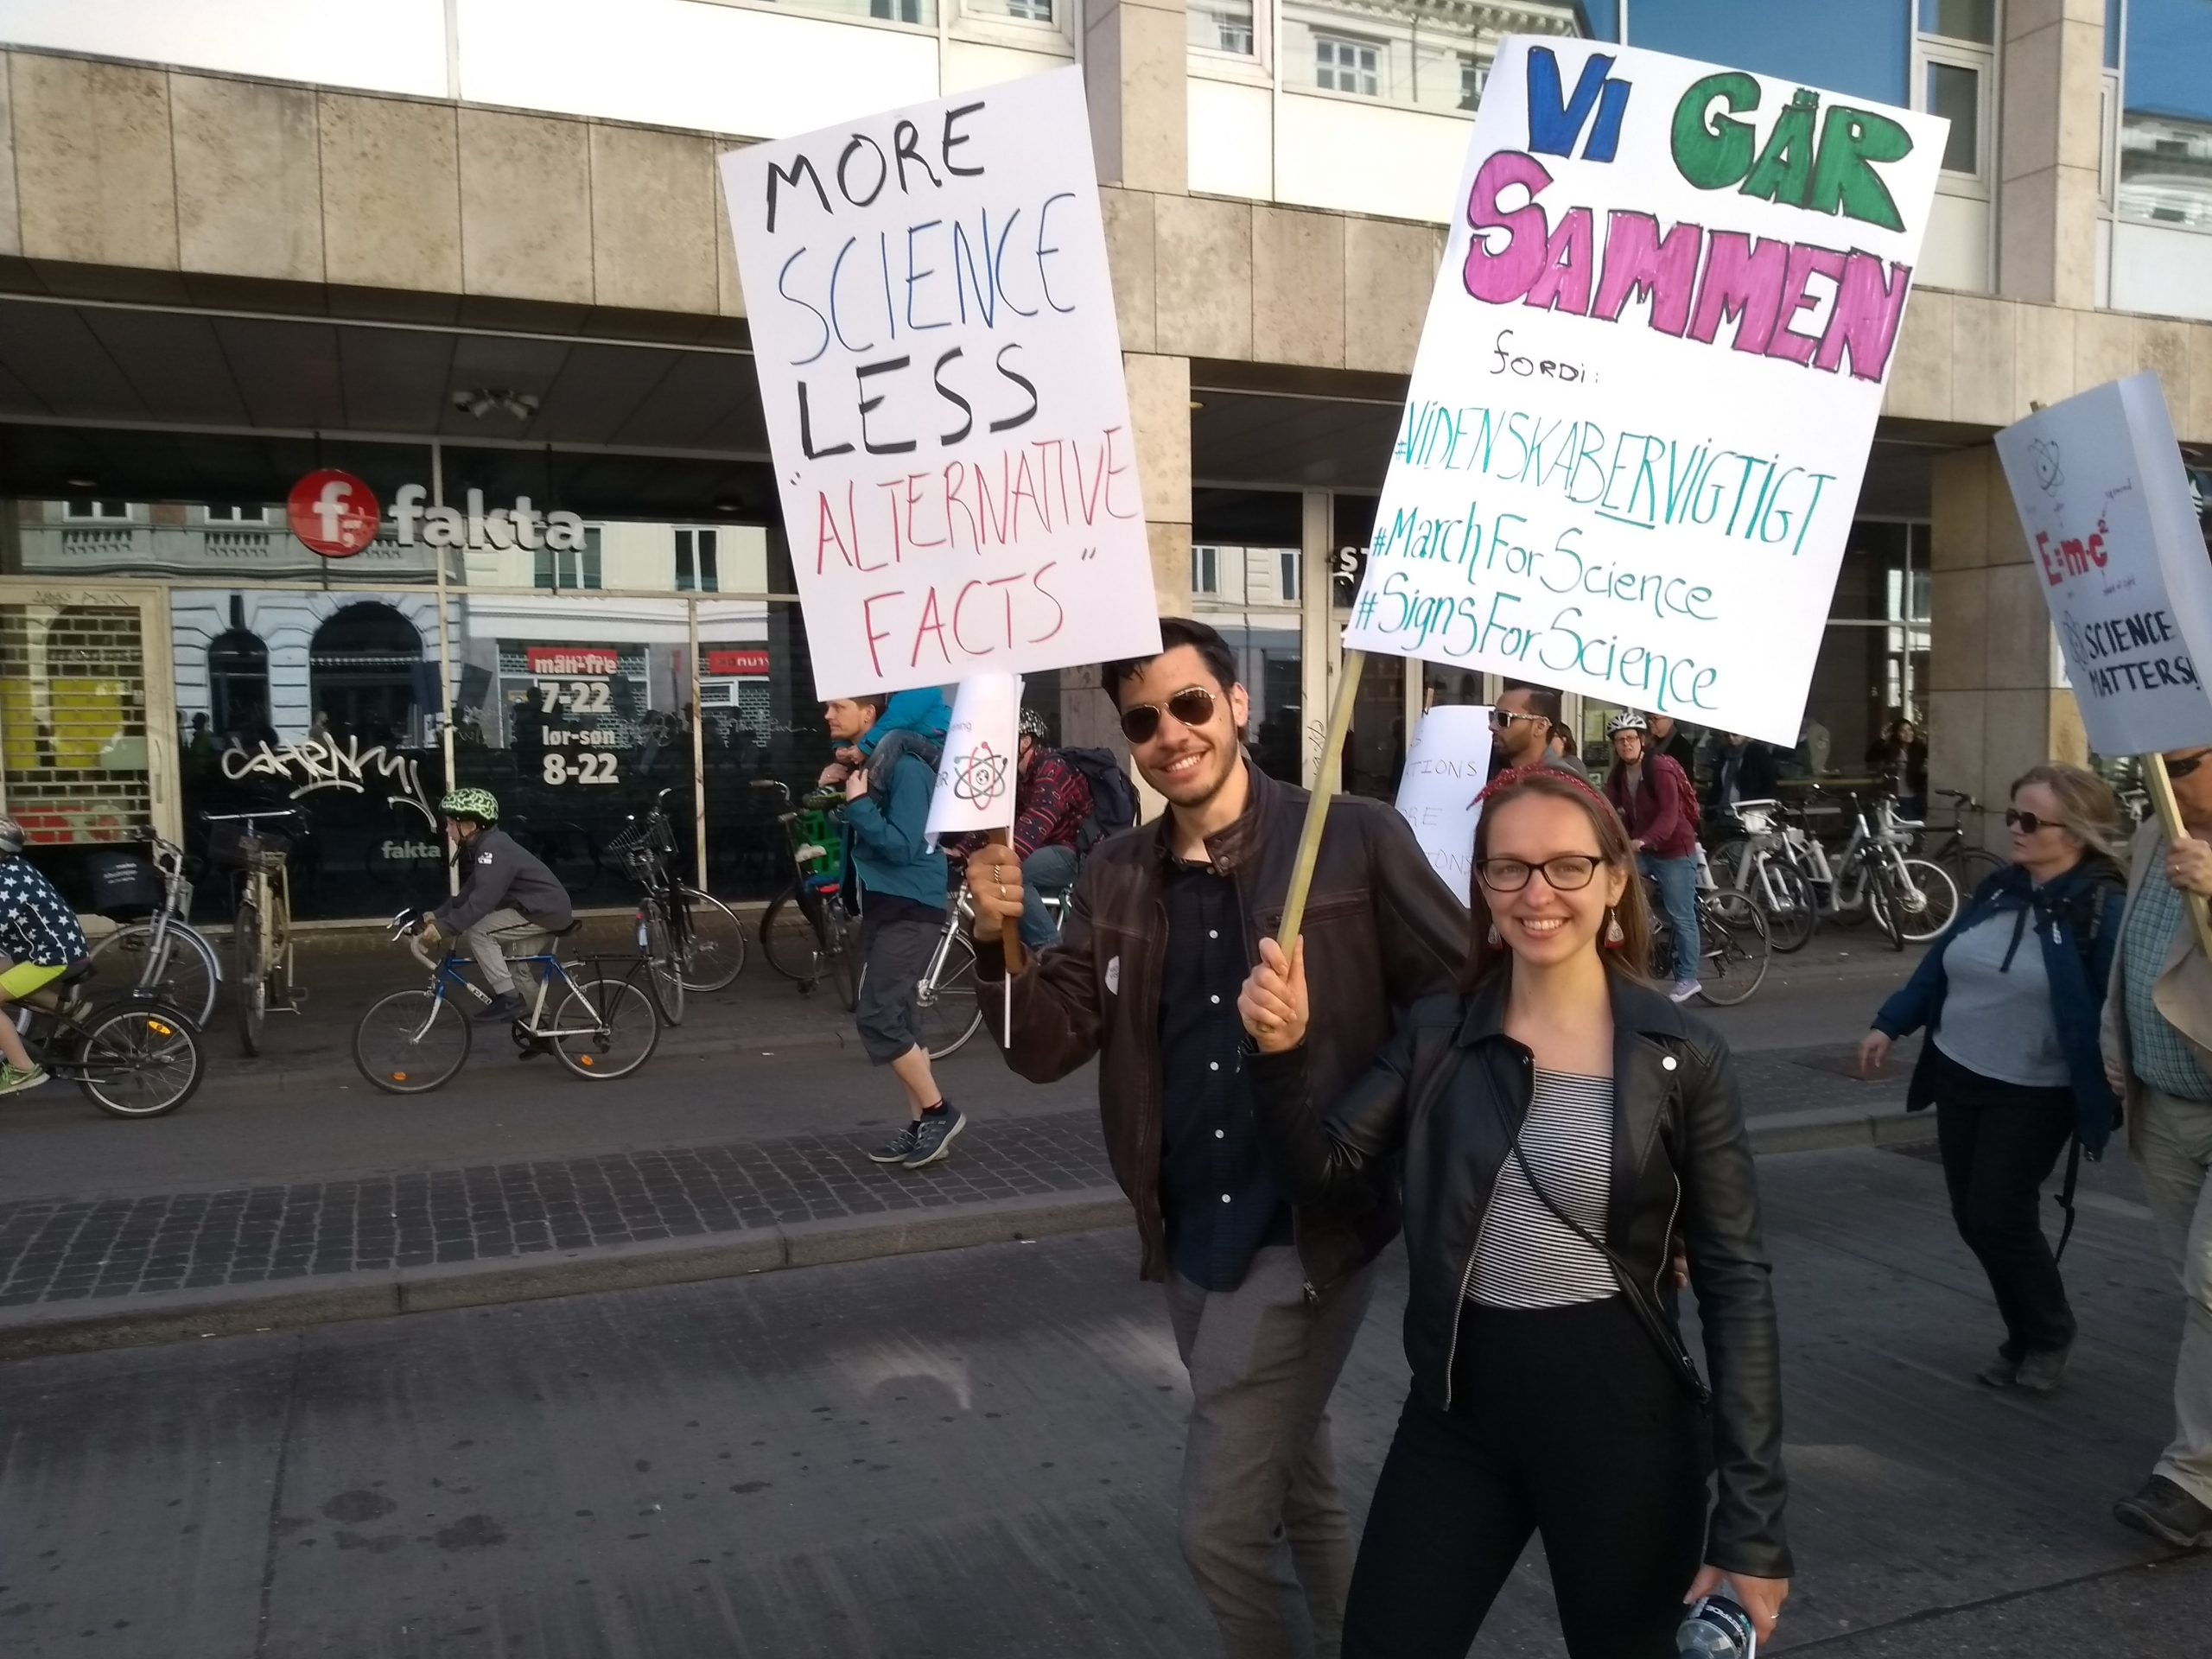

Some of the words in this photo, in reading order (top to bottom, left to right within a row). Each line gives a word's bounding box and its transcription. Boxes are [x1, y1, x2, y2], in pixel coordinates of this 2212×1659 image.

[766, 101, 985, 233] MORE
[1527, 46, 1632, 162] VI
[1670, 71, 1913, 232] GÅR
[779, 193, 1077, 365] SCIENCE
[1463, 149, 1911, 383] SAMMEN
[797, 343, 1038, 459] LESS
[388, 483, 587, 551] fakta
[790, 426, 1139, 575] "ALTERNATIVE
[1339, 546, 1370, 572] S
[1372, 502, 1719, 620] #MarchForScience
[534, 654, 617, 675] man-fre
[1356, 572, 1719, 712] #SignsForScience
[2085, 611, 2177, 659] SCIENCE
[539, 682, 611, 715] 7-22
[2088, 656, 2202, 698] MATTERS!
[542, 725, 616, 747] lør-søn
[543, 753, 620, 785] 8-22
[381, 840, 442, 860] fakta
